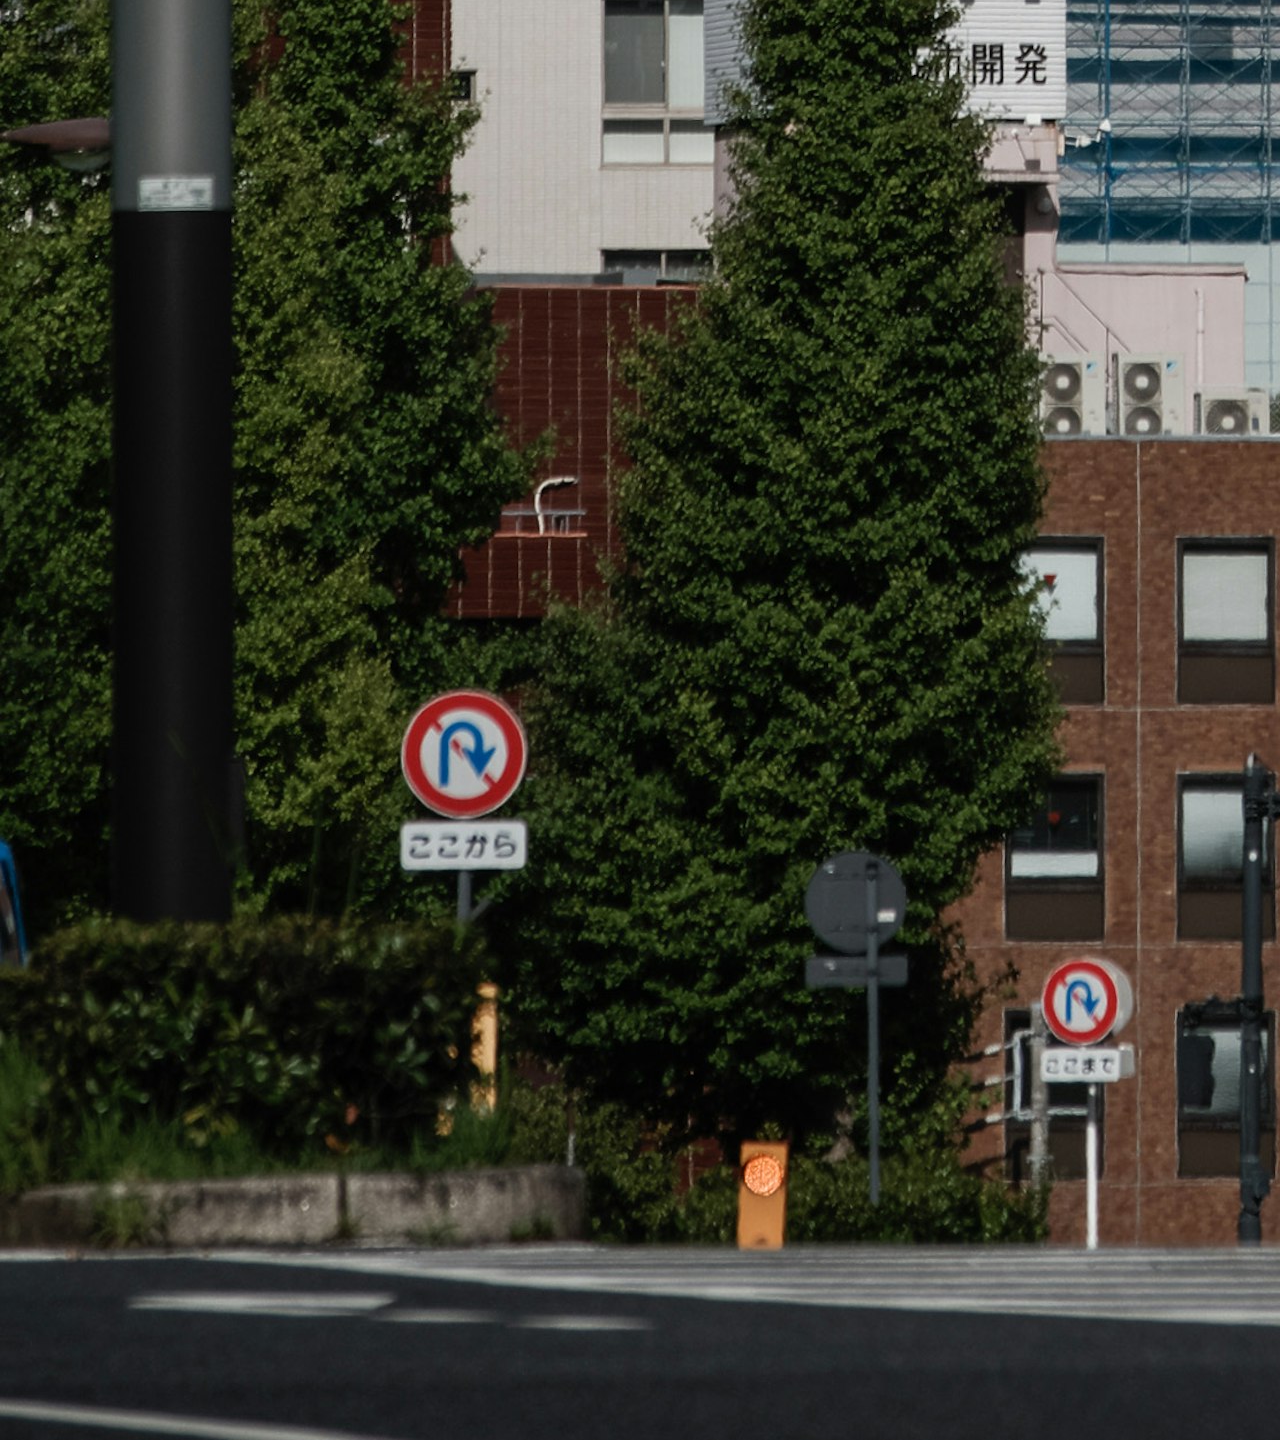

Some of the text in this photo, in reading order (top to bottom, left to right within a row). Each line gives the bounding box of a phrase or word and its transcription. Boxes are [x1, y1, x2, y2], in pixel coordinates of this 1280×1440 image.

[914, 42, 1048, 85] 市開発
[408, 831, 516, 859] ここから
[1046, 1057, 1114, 1075] ここまで
